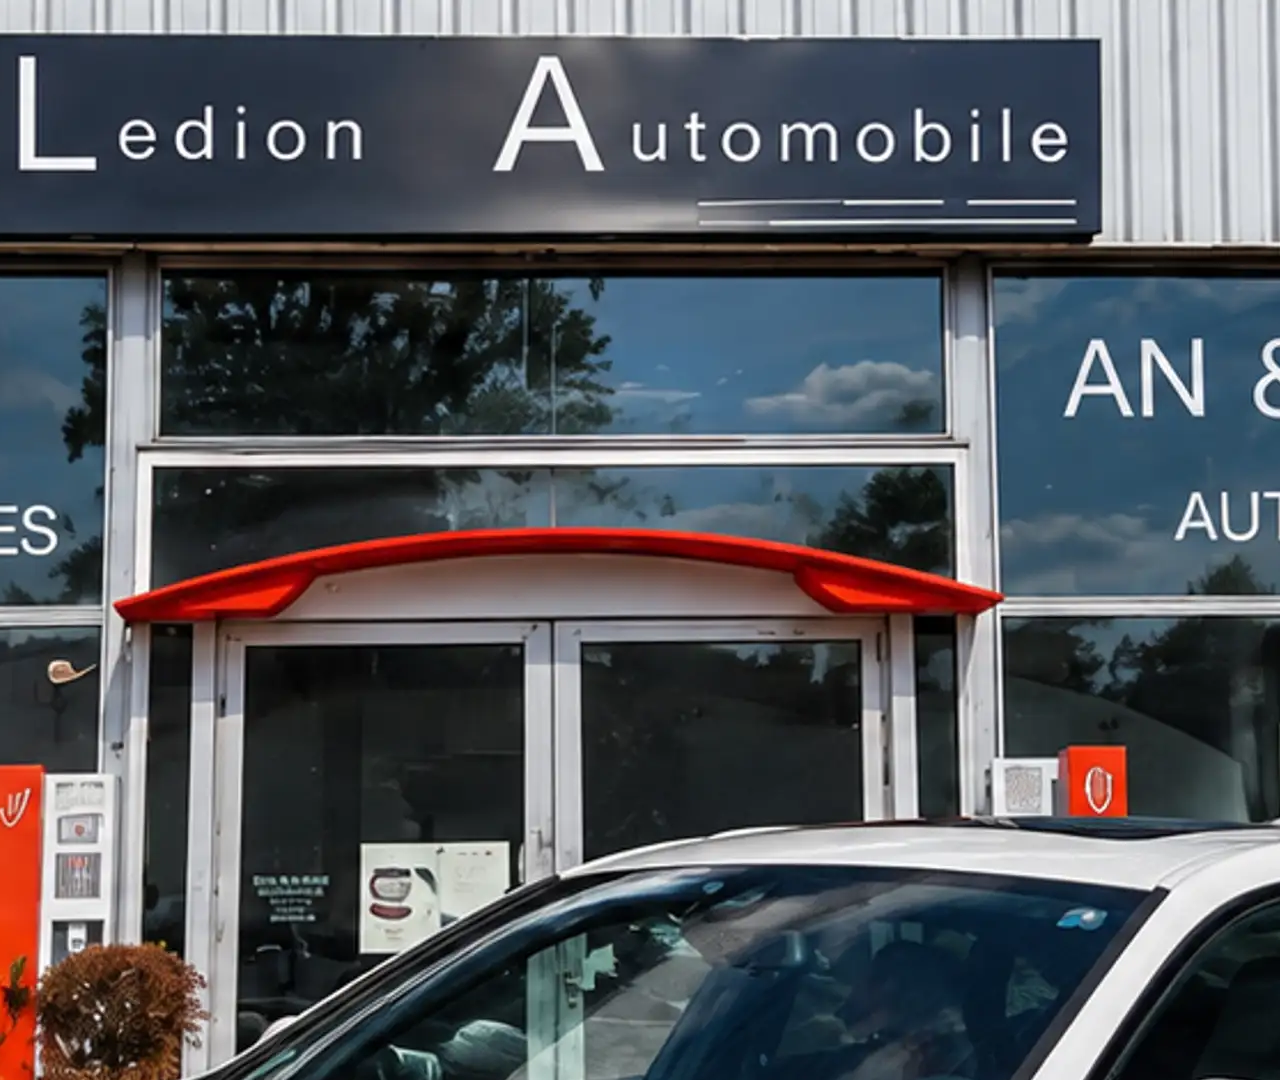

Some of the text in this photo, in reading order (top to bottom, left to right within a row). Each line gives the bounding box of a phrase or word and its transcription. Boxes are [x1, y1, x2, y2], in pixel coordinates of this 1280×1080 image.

[17, 55, 1069, 173] Ledion Automobile
[1063, 338, 1206, 418] AN
